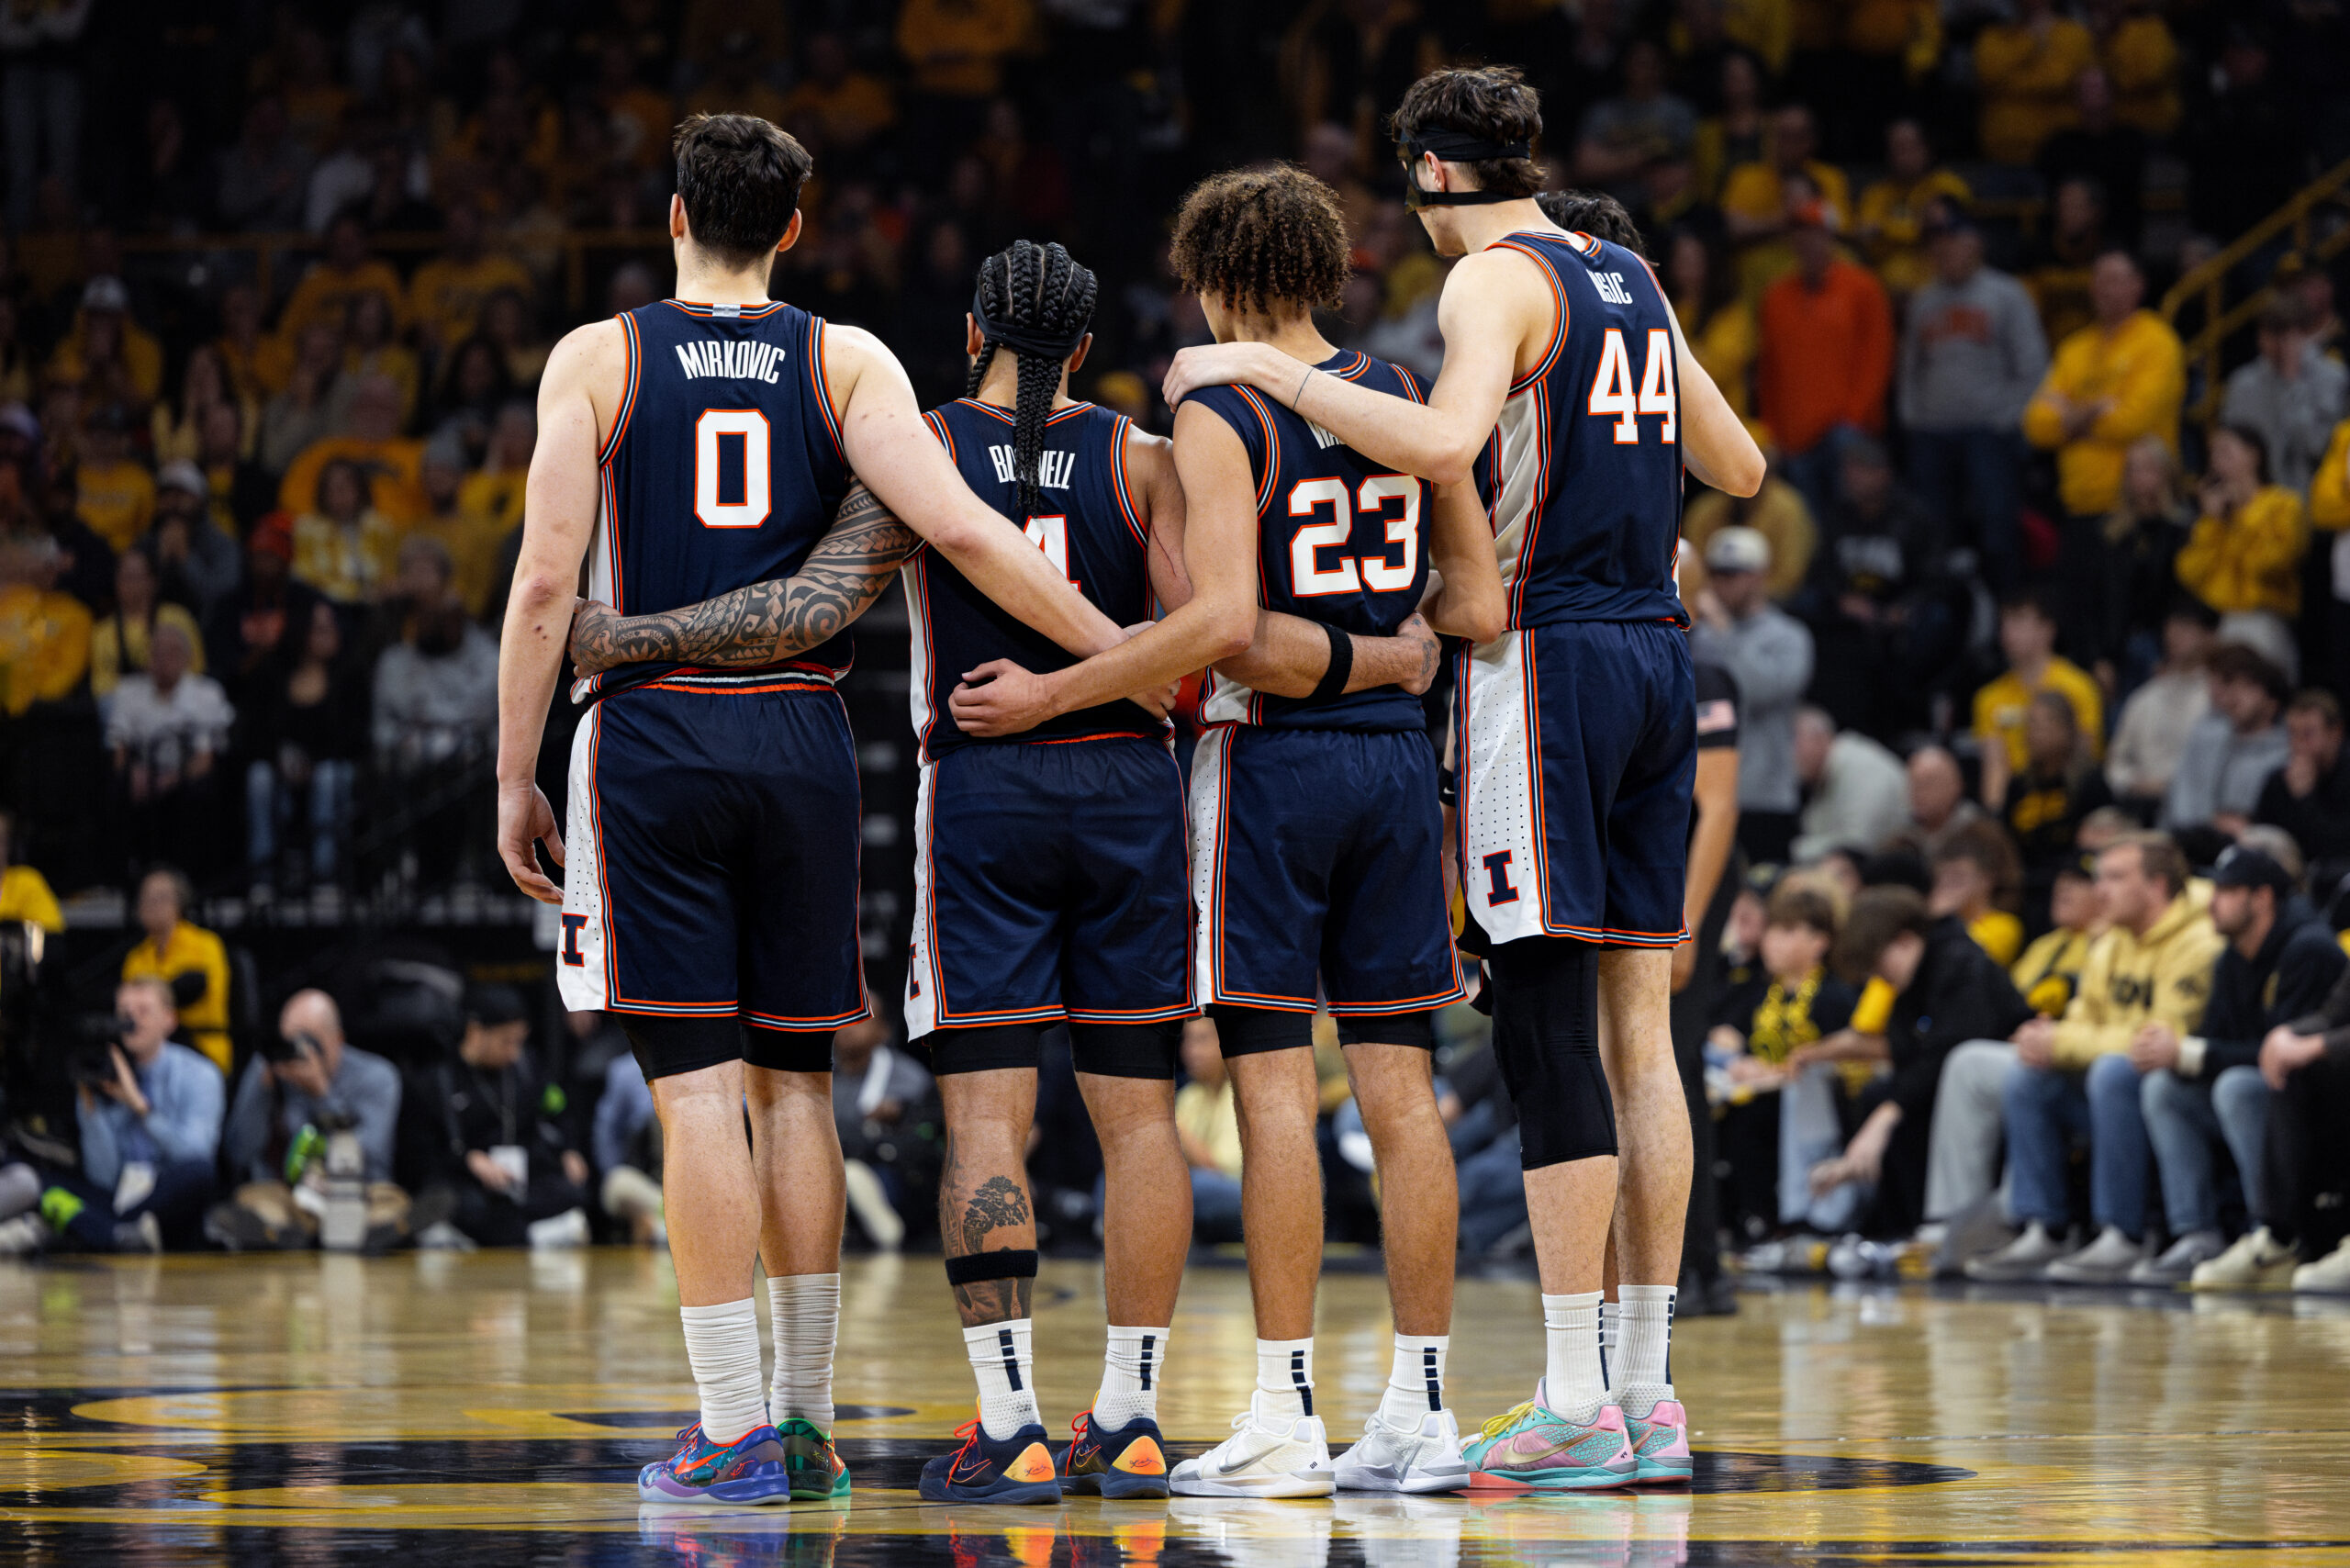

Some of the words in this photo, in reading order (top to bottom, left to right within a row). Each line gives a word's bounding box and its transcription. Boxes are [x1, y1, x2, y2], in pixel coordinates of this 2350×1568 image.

[675, 340, 786, 385] MIRKOVIC
[1588, 328, 1676, 444] 44
[694, 408, 772, 529] 0
[1288, 474, 1422, 598] 23
[1483, 849, 1520, 908] I
[561, 913, 589, 967] I
